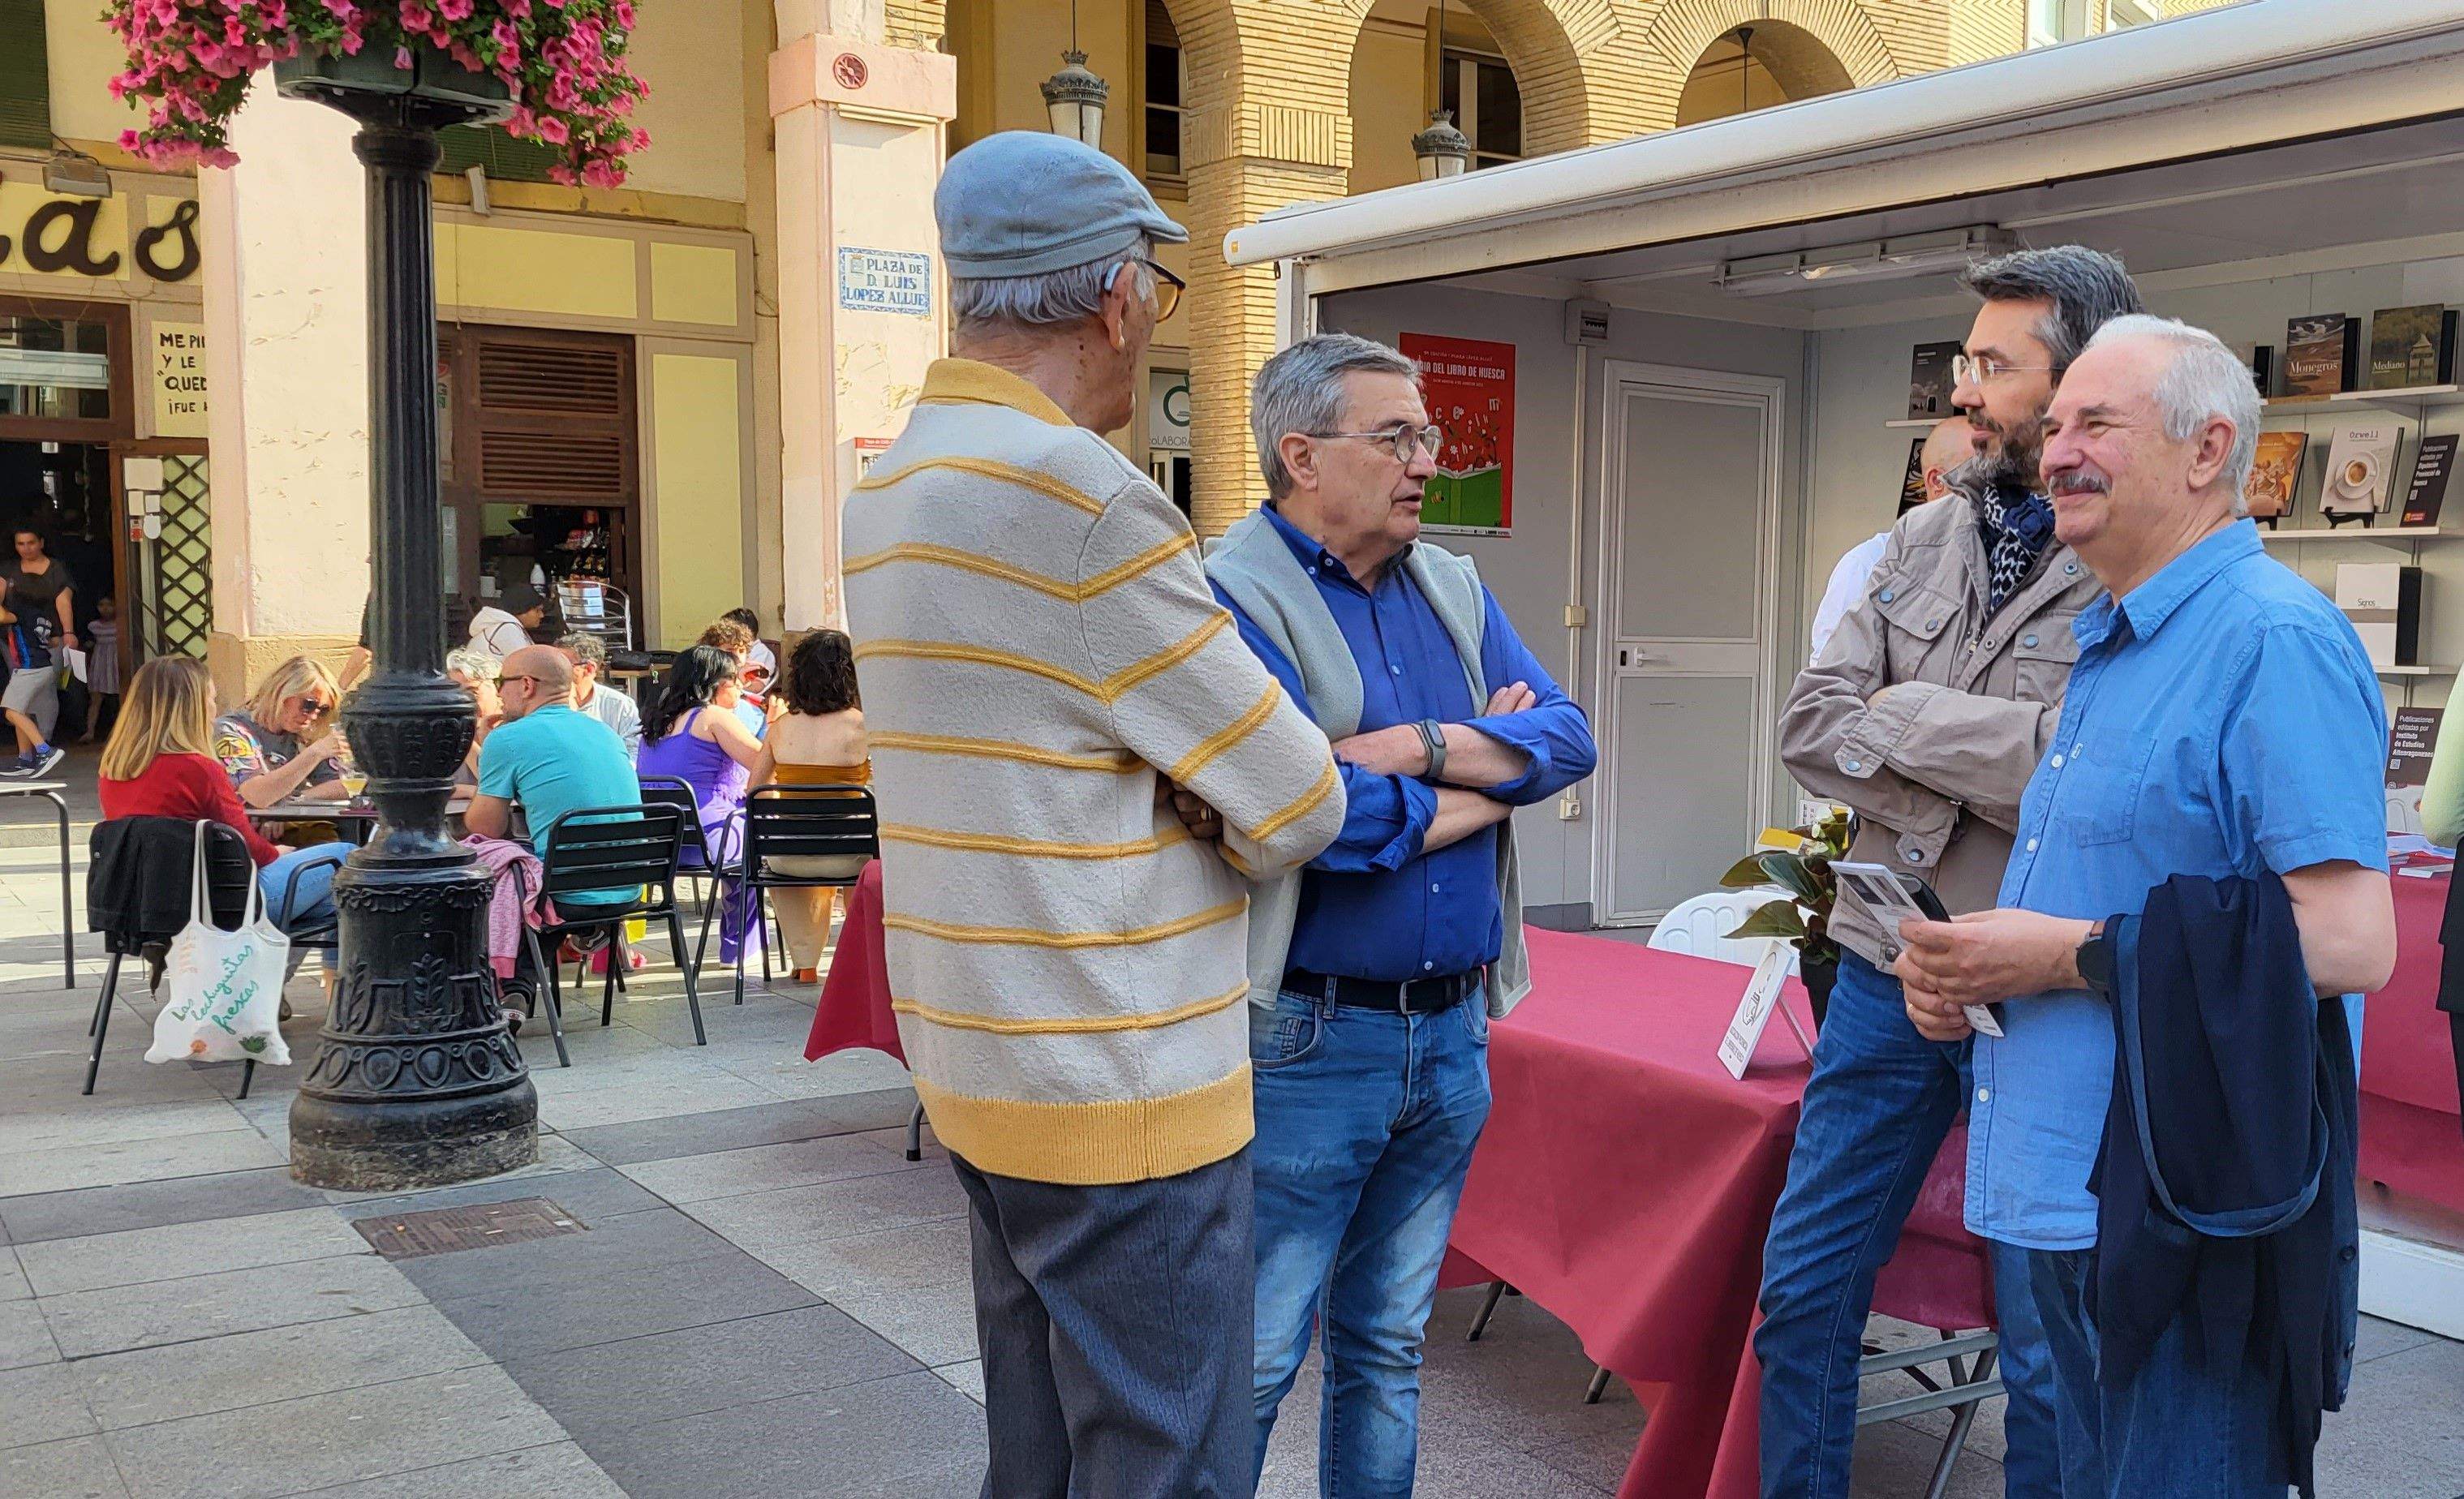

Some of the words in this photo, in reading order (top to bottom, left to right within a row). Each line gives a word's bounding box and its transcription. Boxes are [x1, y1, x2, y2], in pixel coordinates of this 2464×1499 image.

[0, 200, 200, 282] as
[866, 258, 905, 273] PLAZA
[909, 264, 922, 274] DE
[866, 273, 877, 286] D.
[884, 275, 918, 290] LUIS
[846, 287, 885, 303] LOPEZ
[160, 333, 186, 348] ME
[161, 354, 172, 368] Y
[181, 356, 196, 368] LE
[2290, 361, 2338, 374] Monegros
[1432, 362, 1445, 374] DEL
[1447, 363, 1467, 376] LIBRO
[1469, 366, 1477, 378] DE
[1478, 367, 1506, 381] HUESCA
